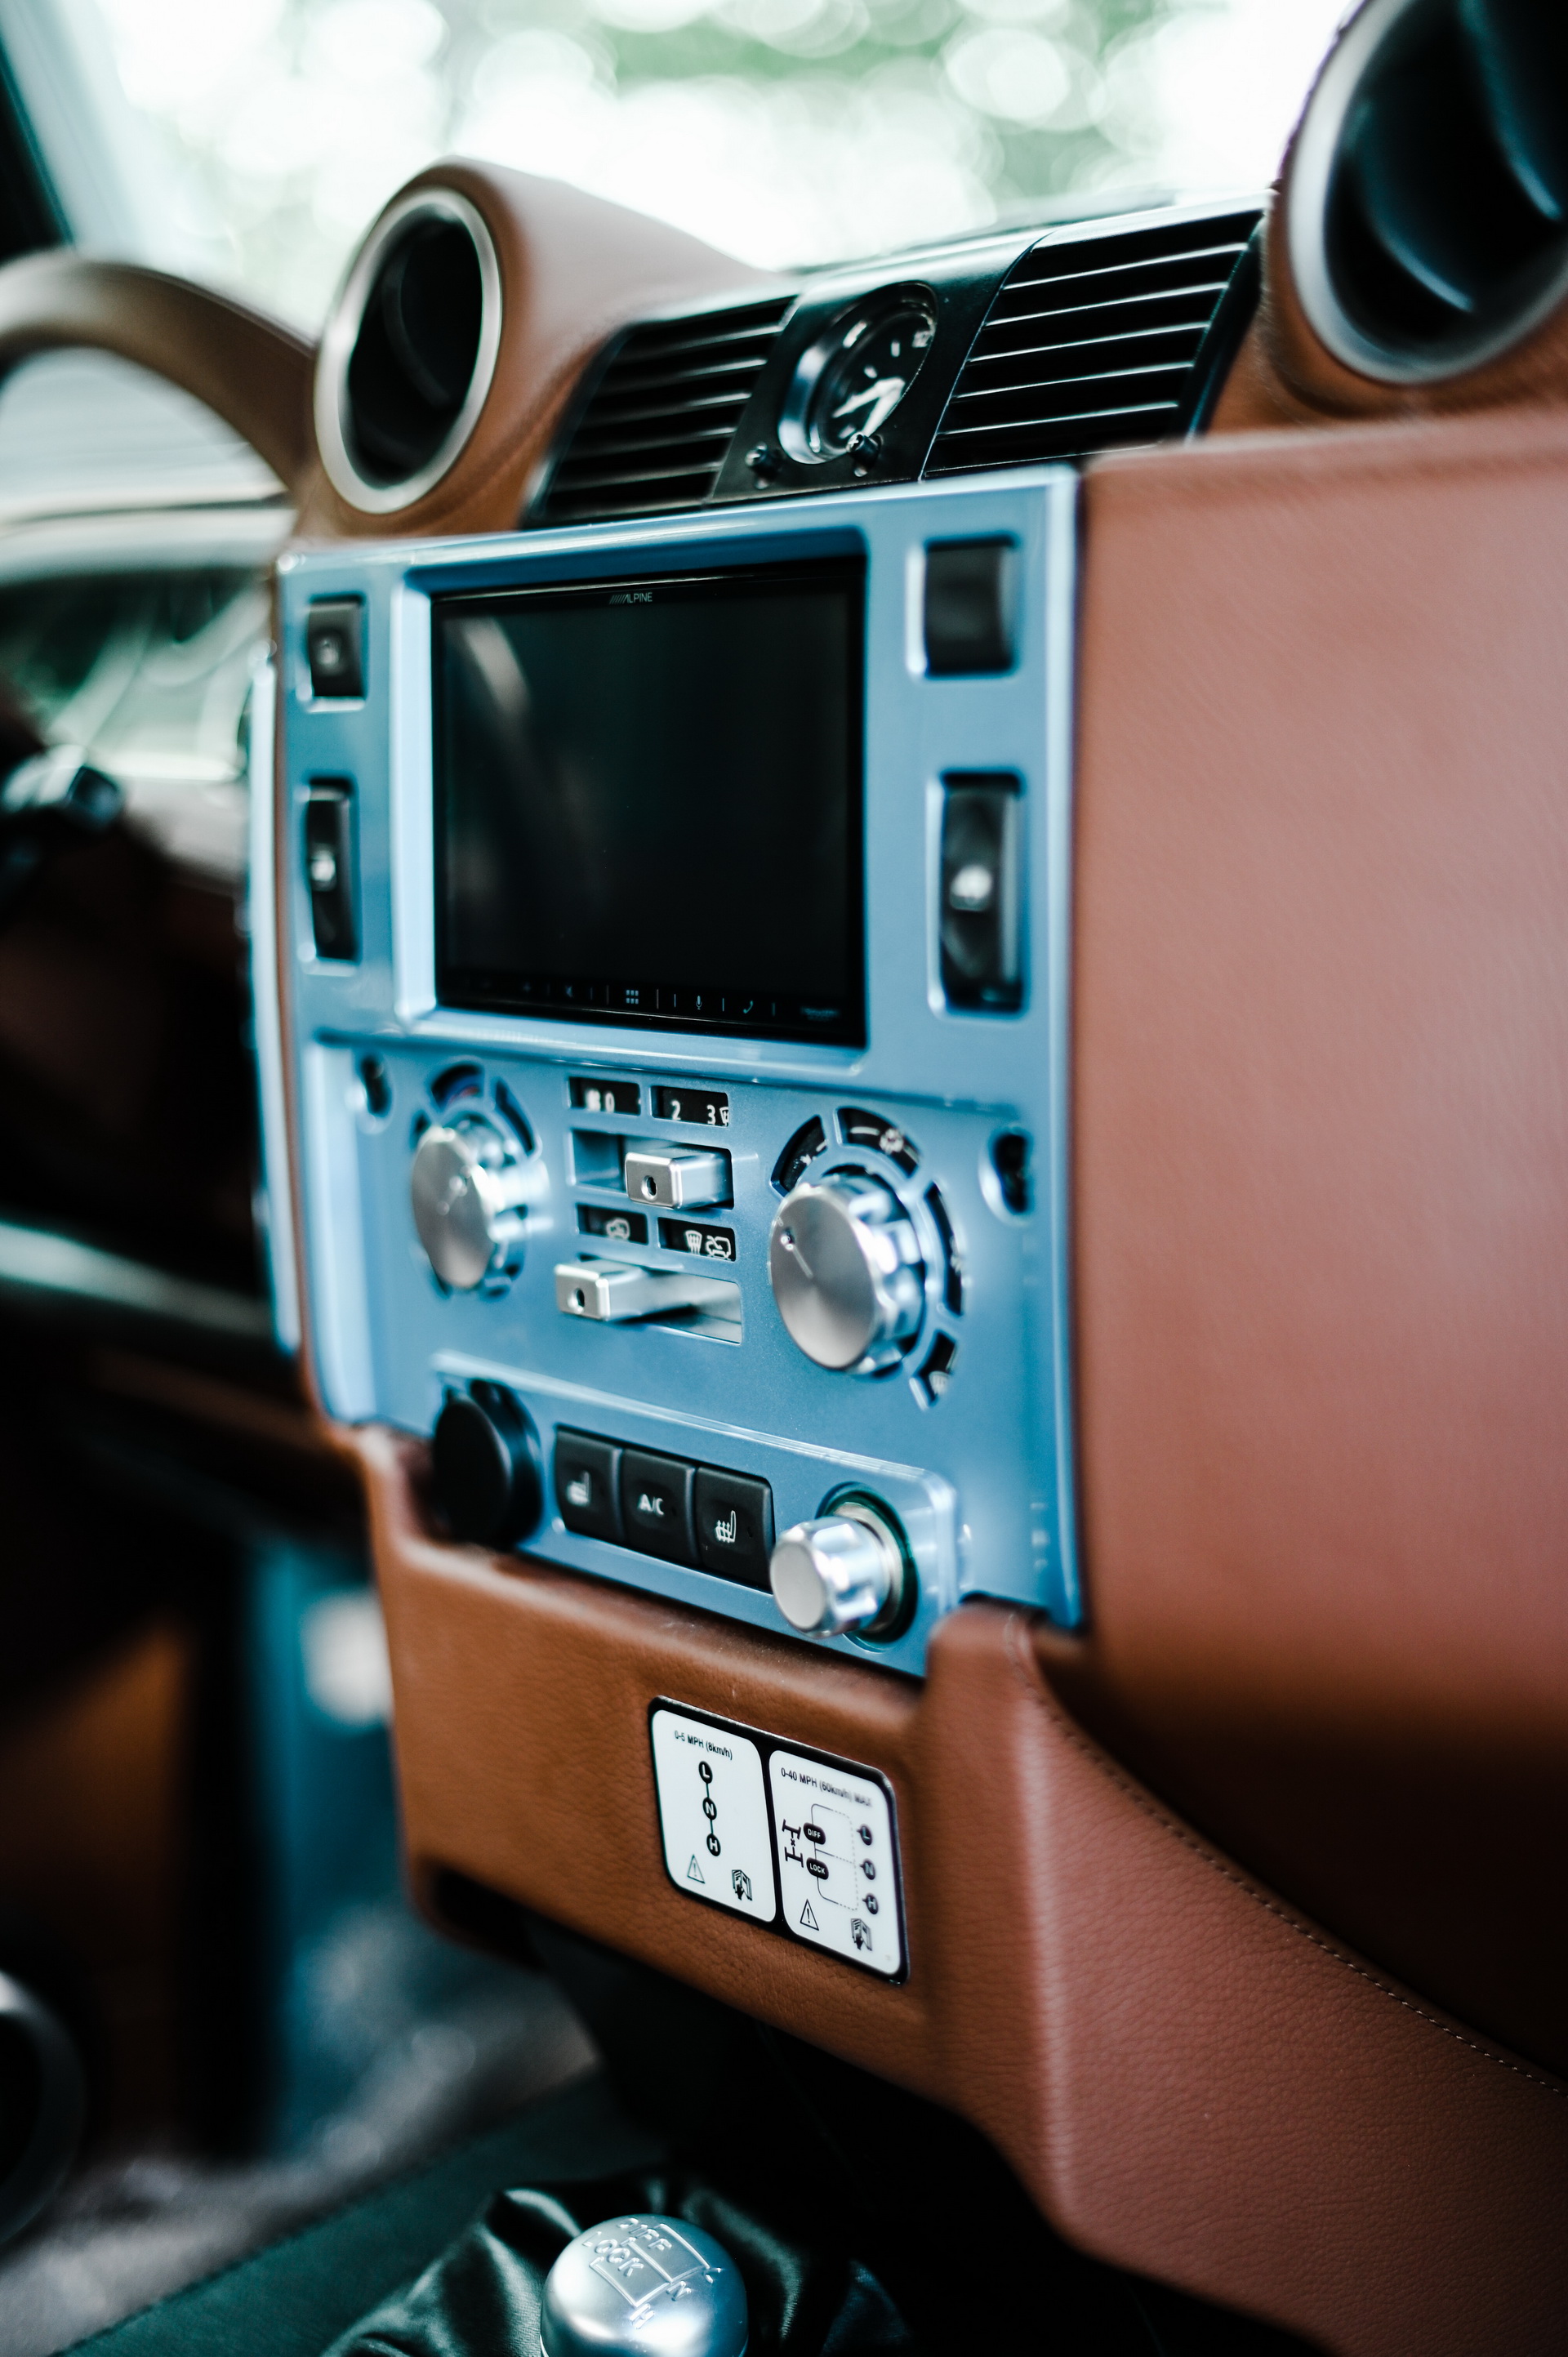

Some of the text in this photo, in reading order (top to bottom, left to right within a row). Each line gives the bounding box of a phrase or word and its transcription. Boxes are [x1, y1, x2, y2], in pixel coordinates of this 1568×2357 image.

[610, 592, 653, 604] ALPINE
[672, 1100, 681, 1121] 2
[707, 1104, 716, 1125] 3
[638, 1494, 664, 1516] A/C
[675, 1730, 733, 1761] 0-5 MPH (8km/h)
[702, 1765, 710, 1779] L
[781, 1767, 797, 1781] 0-40
[800, 1773, 817, 1788] MPH
[706, 1801, 715, 1816] N
[808, 1829, 821, 1839] DIFF
[862, 1827, 871, 1841] L
[710, 1838, 718, 1852] H
[809, 1863, 826, 1874] LOCK
[865, 1863, 875, 1877] N
[867, 1899, 876, 1911] H
[581, 2231, 644, 2277] LOCK
